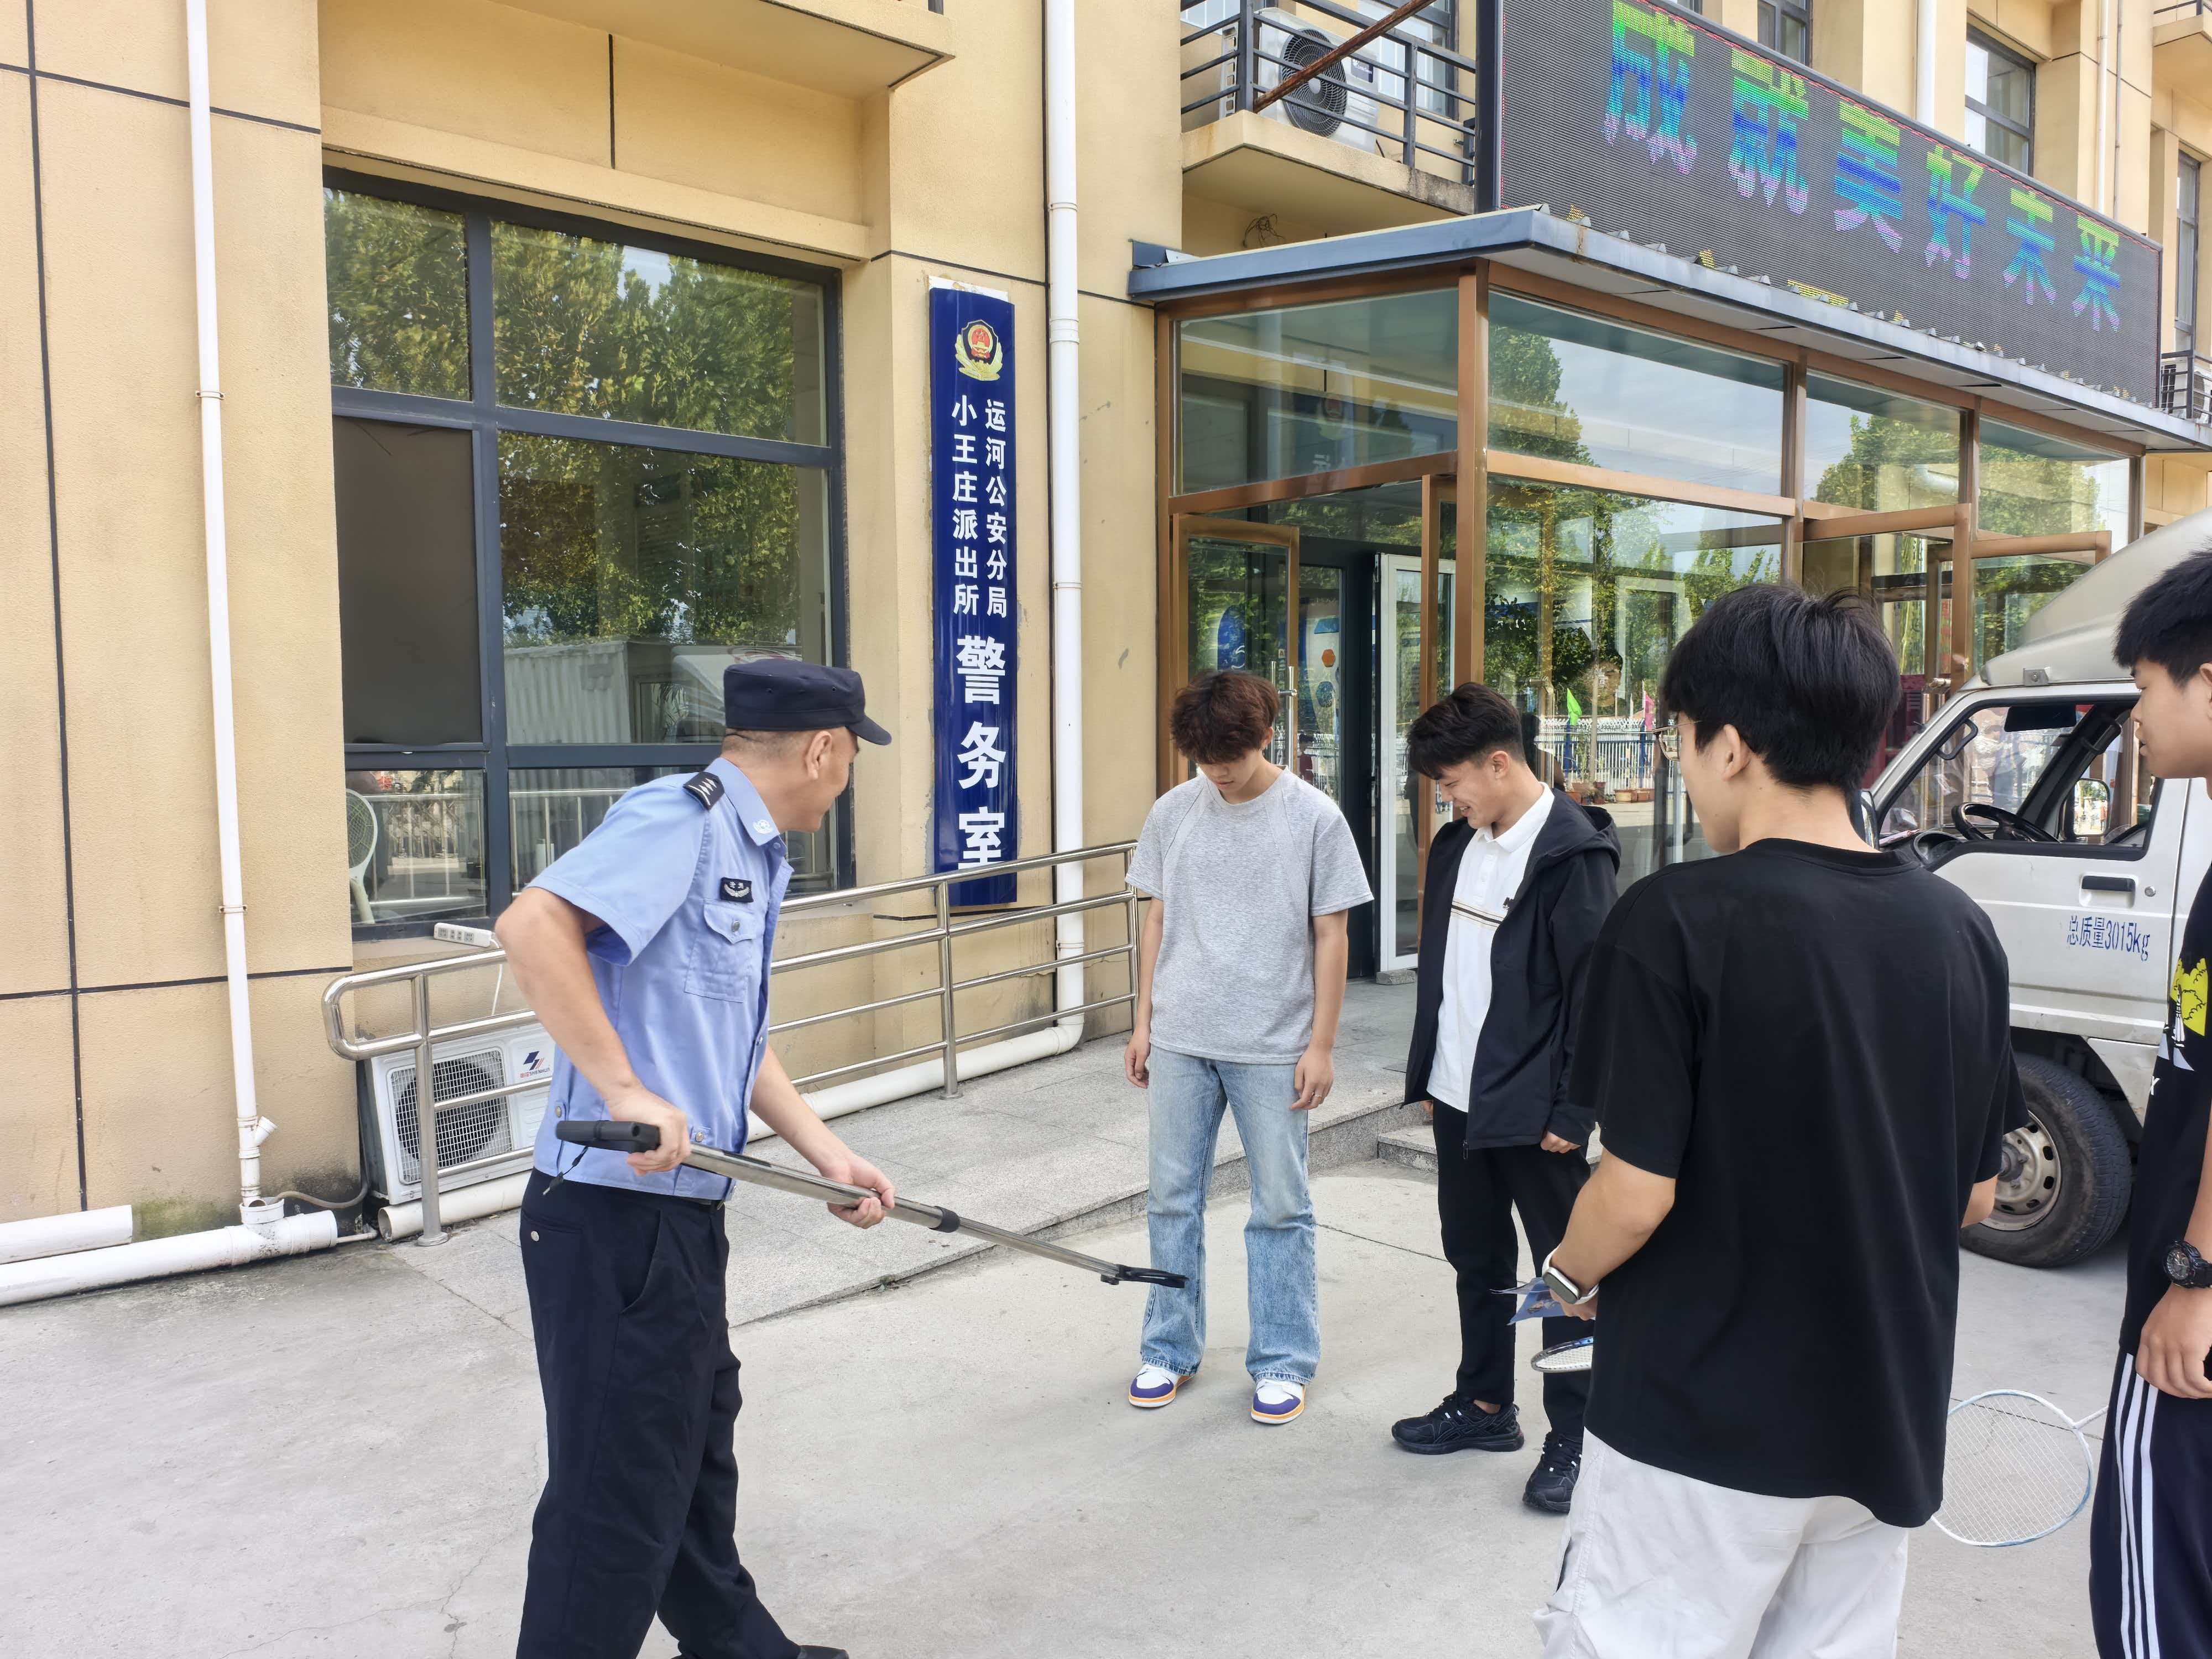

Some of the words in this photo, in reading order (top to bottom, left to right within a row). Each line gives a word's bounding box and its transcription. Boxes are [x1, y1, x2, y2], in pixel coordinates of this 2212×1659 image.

[1601, 0, 2120, 332] 成就美好未来
[951, 395, 978, 615] 小王庄派出所
[985, 399, 1008, 618] 运河公安分局
[957, 635, 1006, 870] 警务室
[2067, 915, 2151, 961] 总质量3015kg
